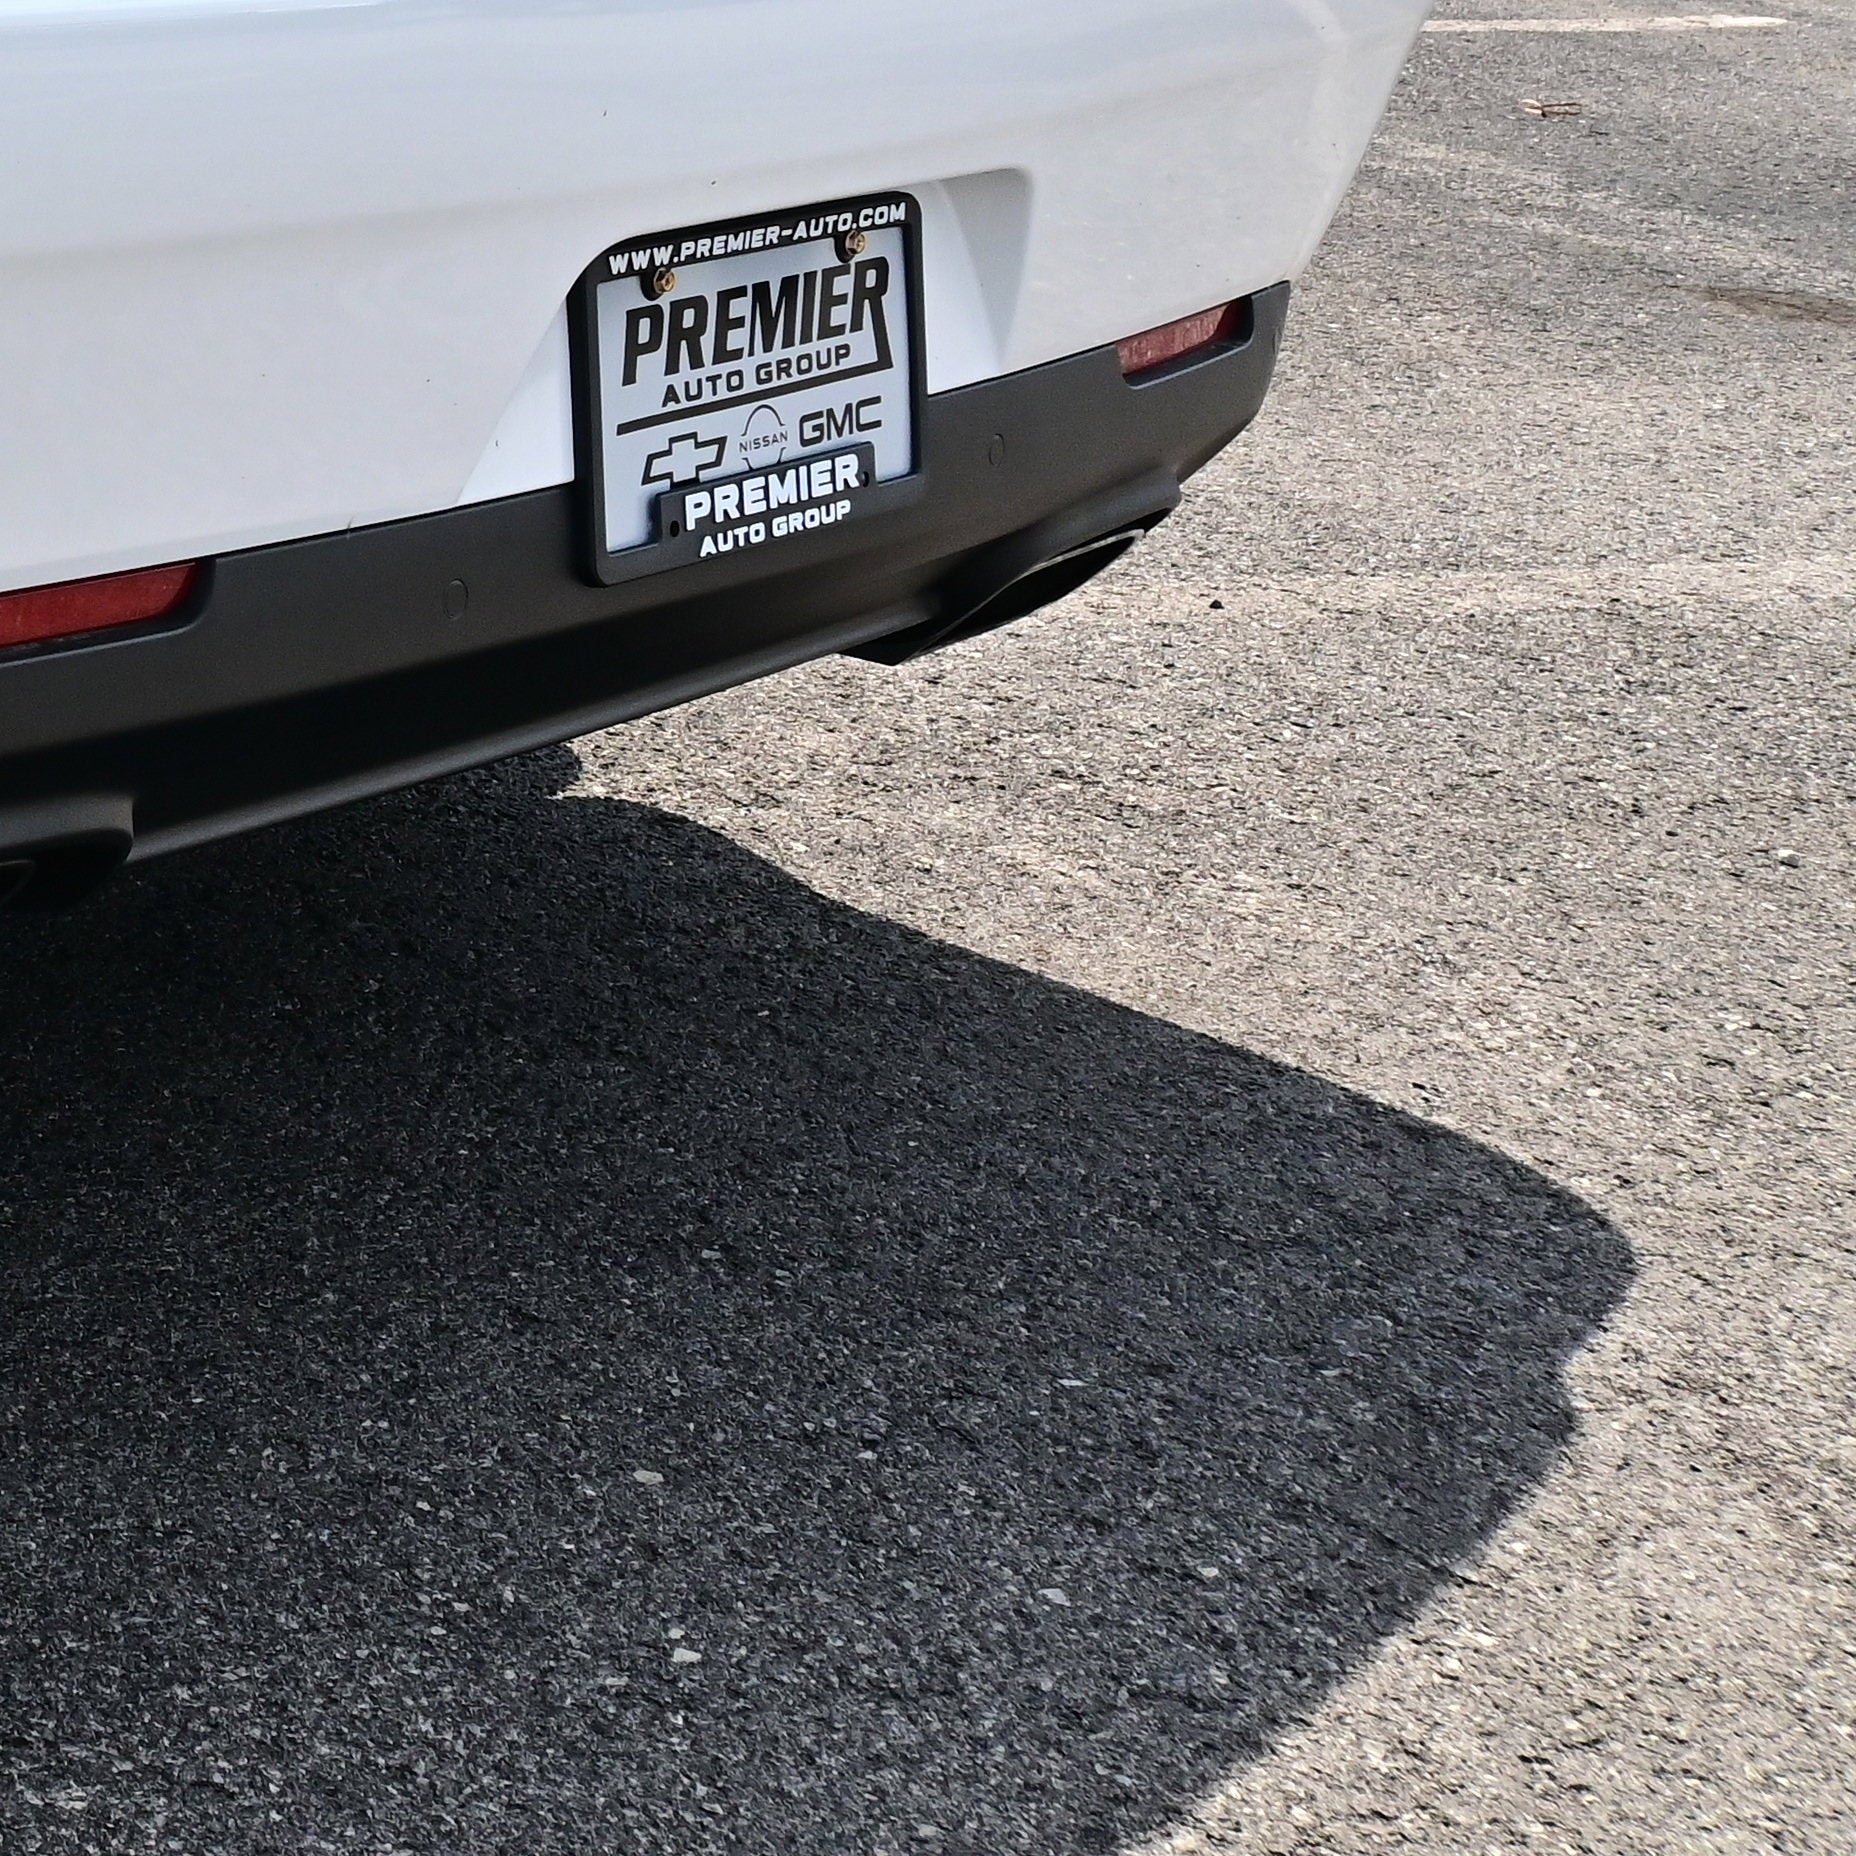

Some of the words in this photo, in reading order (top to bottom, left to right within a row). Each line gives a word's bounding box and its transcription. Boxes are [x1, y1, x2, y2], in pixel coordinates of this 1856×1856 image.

[608, 201, 907, 275] WWW.PREMIER-AUTO.COM
[621, 255, 893, 387] PREMIER
[661, 367, 744, 408] AUTO
[755, 343, 852, 386] GROUP
[738, 429, 789, 454] NISSAN
[798, 395, 883, 448] GMC
[684, 452, 860, 531] PREMIER
[699, 521, 766, 558] AUTO
[772, 500, 852, 538] GROUP
